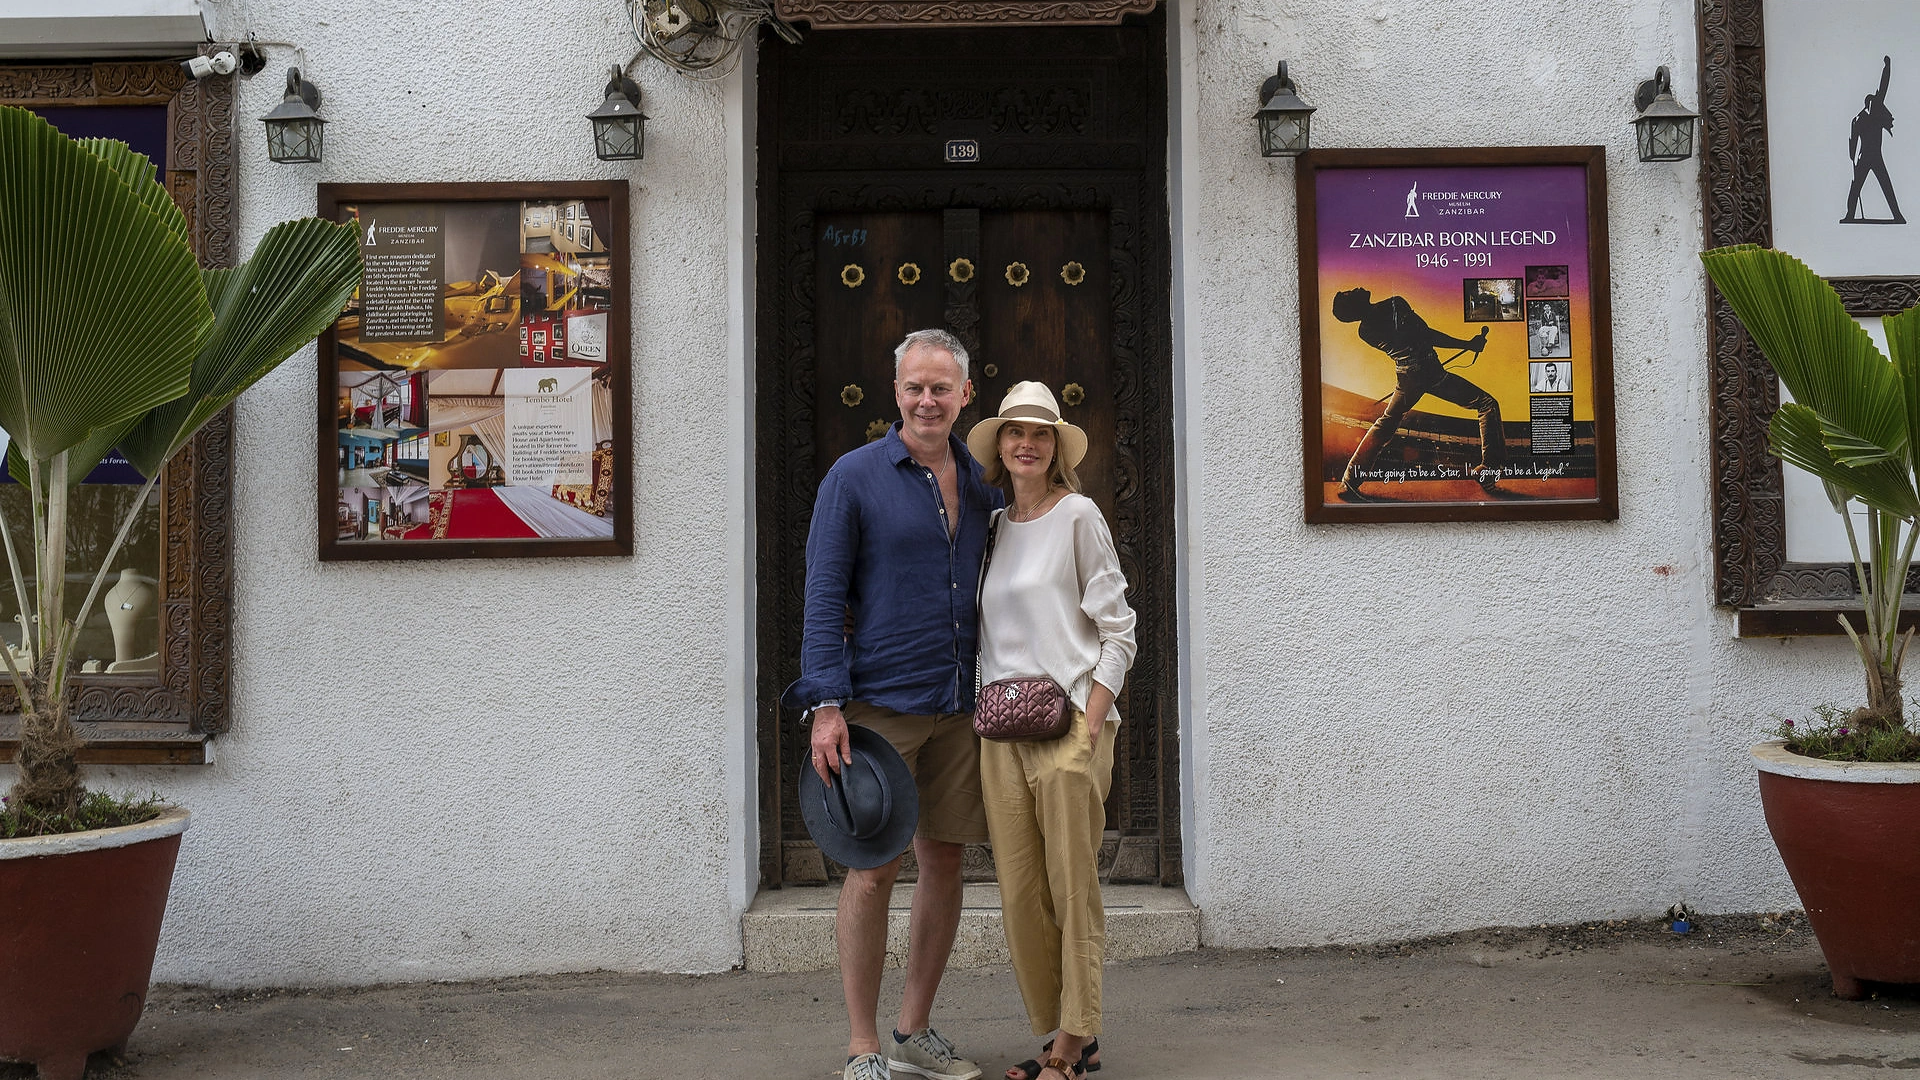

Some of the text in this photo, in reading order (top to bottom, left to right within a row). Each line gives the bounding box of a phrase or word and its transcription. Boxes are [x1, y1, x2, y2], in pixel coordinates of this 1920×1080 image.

[950, 144, 975, 158] 139
[1422, 191, 1502, 200] FREDDIE MERCURY
[1349, 230, 1557, 248] ZANZIBAR BORN LEGEND
[1416, 252, 1449, 268] 1946
[1464, 252, 1492, 267] 1991
[571, 342, 601, 357] QUEEN
[525, 395, 573, 403] Tembo Hotel
[1369, 469, 1384, 478] not
[1383, 468, 1406, 484] going
[1408, 467, 1417, 478] to
[1418, 464, 1429, 477] be
[1437, 464, 1461, 478] Star,
[1465, 462, 1478, 476] I'm
[1480, 467, 1502, 483] going
[1503, 466, 1513, 476] to
[1514, 463, 1525, 475] be
[1525, 468, 1533, 476] a
